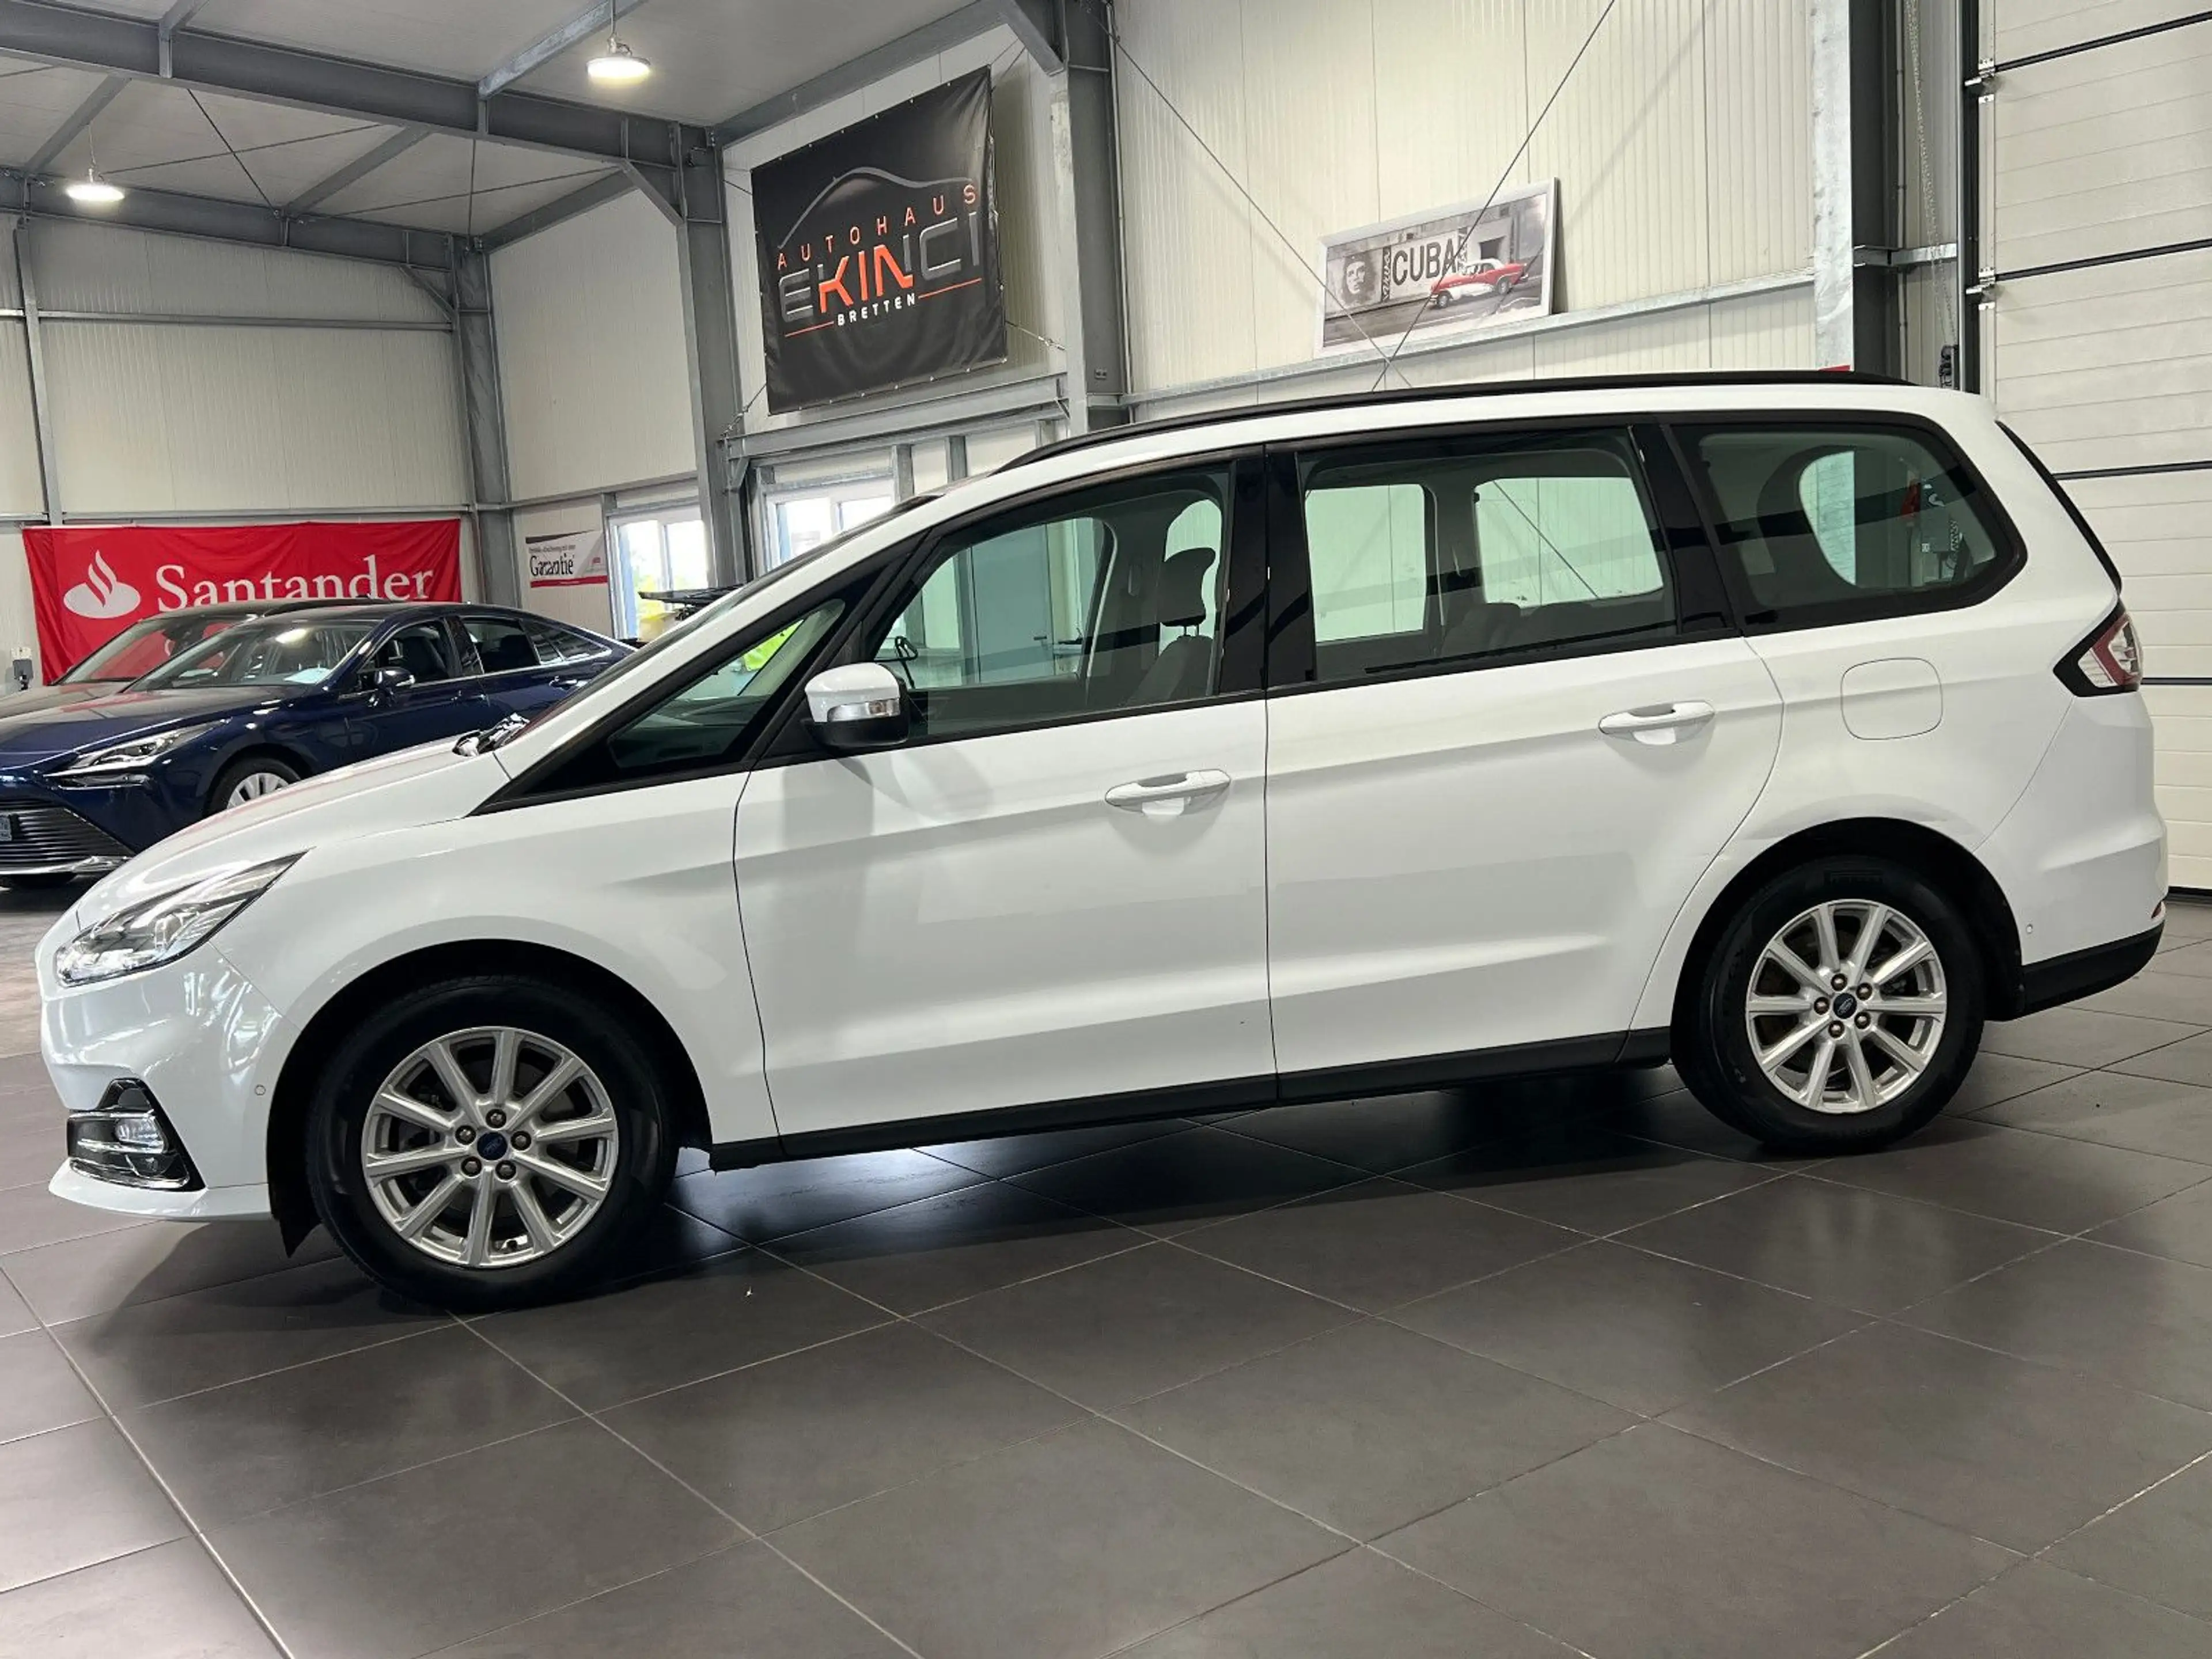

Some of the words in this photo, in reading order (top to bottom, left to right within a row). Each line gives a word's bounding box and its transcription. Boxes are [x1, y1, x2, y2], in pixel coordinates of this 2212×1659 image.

[778, 184, 976, 270] AUTOHAUS
[778, 211, 979, 323] EKINCI
[1392, 238, 1457, 286] CUBA
[838, 293, 915, 326] BRETTEN
[156, 554, 434, 612] Santander
[529, 552, 574, 577] Garantie
